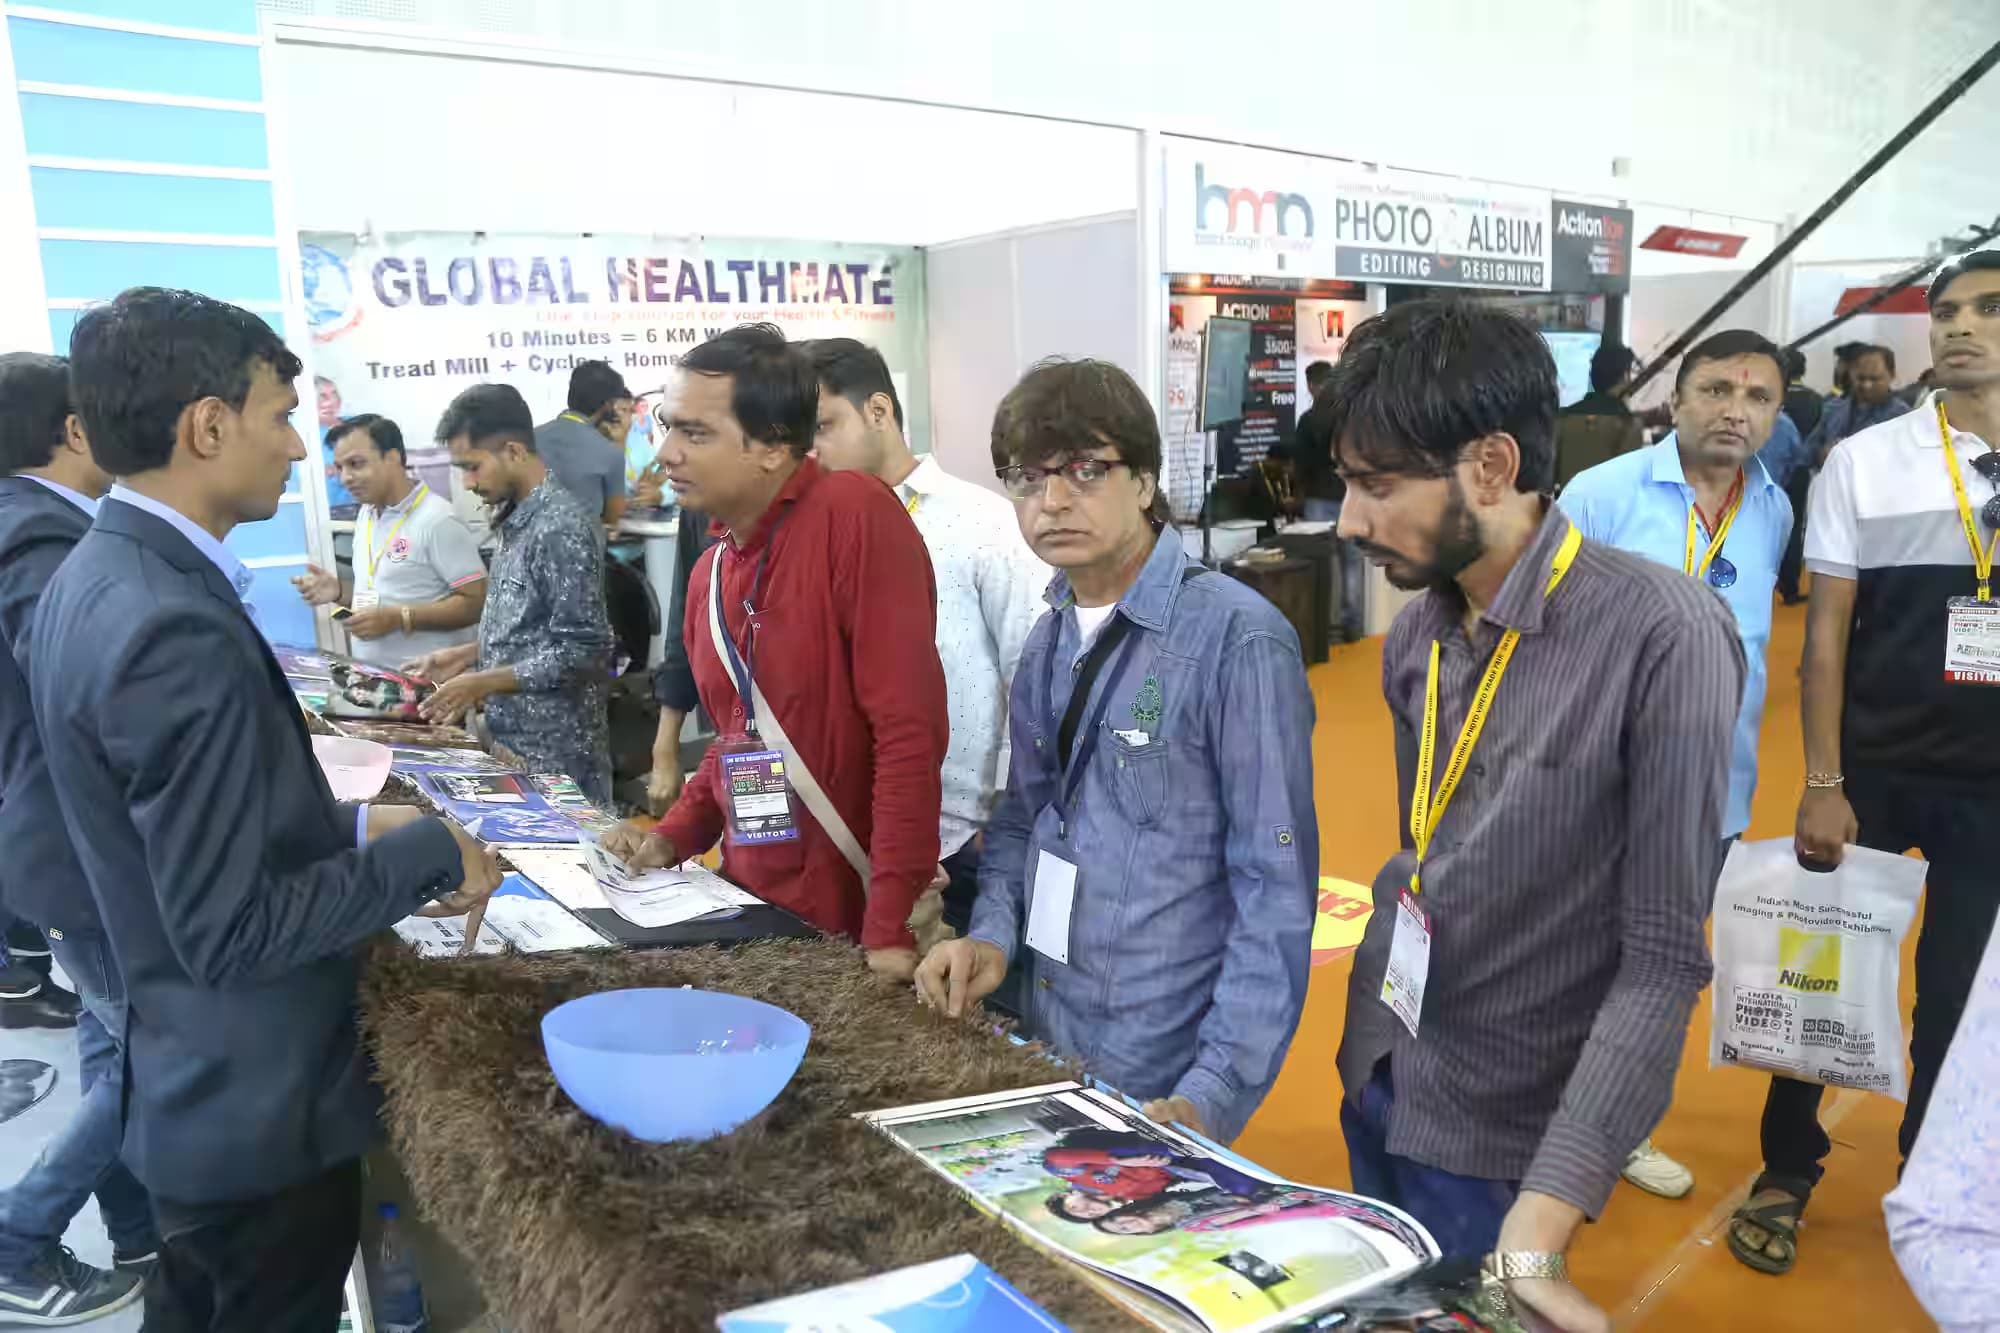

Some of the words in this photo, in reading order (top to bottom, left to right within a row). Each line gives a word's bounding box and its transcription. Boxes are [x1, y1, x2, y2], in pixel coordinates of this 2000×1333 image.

[1335, 198, 1432, 246] PHOTO
[1467, 213, 1543, 257] ALBUM
[1360, 253, 1431, 277] EDITING
[1461, 260, 1543, 287] DESIGNING
[371, 256, 589, 308] GLOBAL
[606, 257, 894, 305] HEALTHMATE
[734, 311, 768, 322] your
[487, 330, 513, 349] 10
[521, 328, 611, 348] Minutes
[646, 328, 657, 343] 6
[666, 327, 696, 343] KM
[366, 359, 436, 380] Tread
[445, 357, 489, 376] Mill
[1466, 713, 1481, 739] PHOTO
[746, 830, 787, 839] VISITOR
[1732, 903, 1773, 920] Imaging
[1776, 911, 1784, 919] &
[1787, 911, 1842, 927] Photovideo
[1756, 895, 1790, 907] India's
[1792, 899, 1815, 913] Most
[1778, 968, 1840, 993] Nikon
[1735, 1003, 1783, 1020] PHOTO
[1735, 1013, 1782, 1031] VIDEO
[1800, 1033, 1843, 1046] MAHATMA
